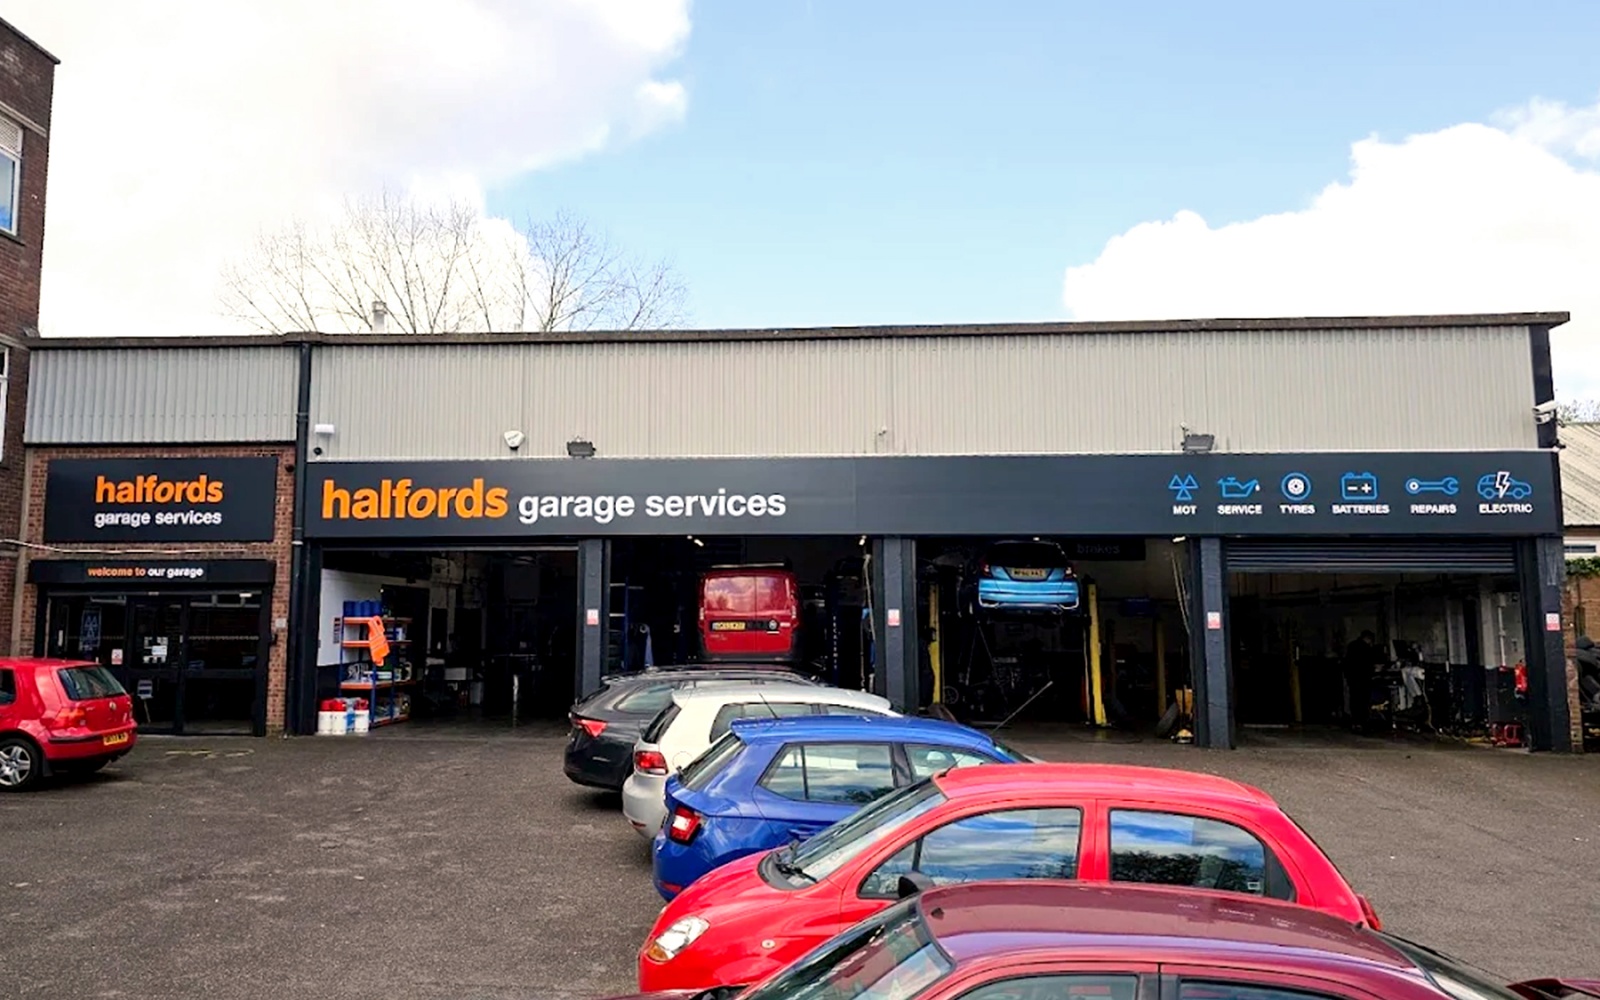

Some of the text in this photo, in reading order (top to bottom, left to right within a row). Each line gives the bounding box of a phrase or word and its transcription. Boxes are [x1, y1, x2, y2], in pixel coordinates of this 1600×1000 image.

[95, 474, 224, 504] halfords
[321, 477, 787, 525] halfords garage services
[1172, 504, 1198, 515] MOT
[1217, 504, 1263, 515] SERVICE
[1279, 504, 1316, 515] TYRES
[1332, 504, 1390, 515] BATTERIES
[1410, 503, 1457, 514] REPAIRS
[1479, 503, 1533, 514] ELECTRIC
[94, 510, 223, 527] garage services
[88, 566, 203, 579] welcome to our garage
